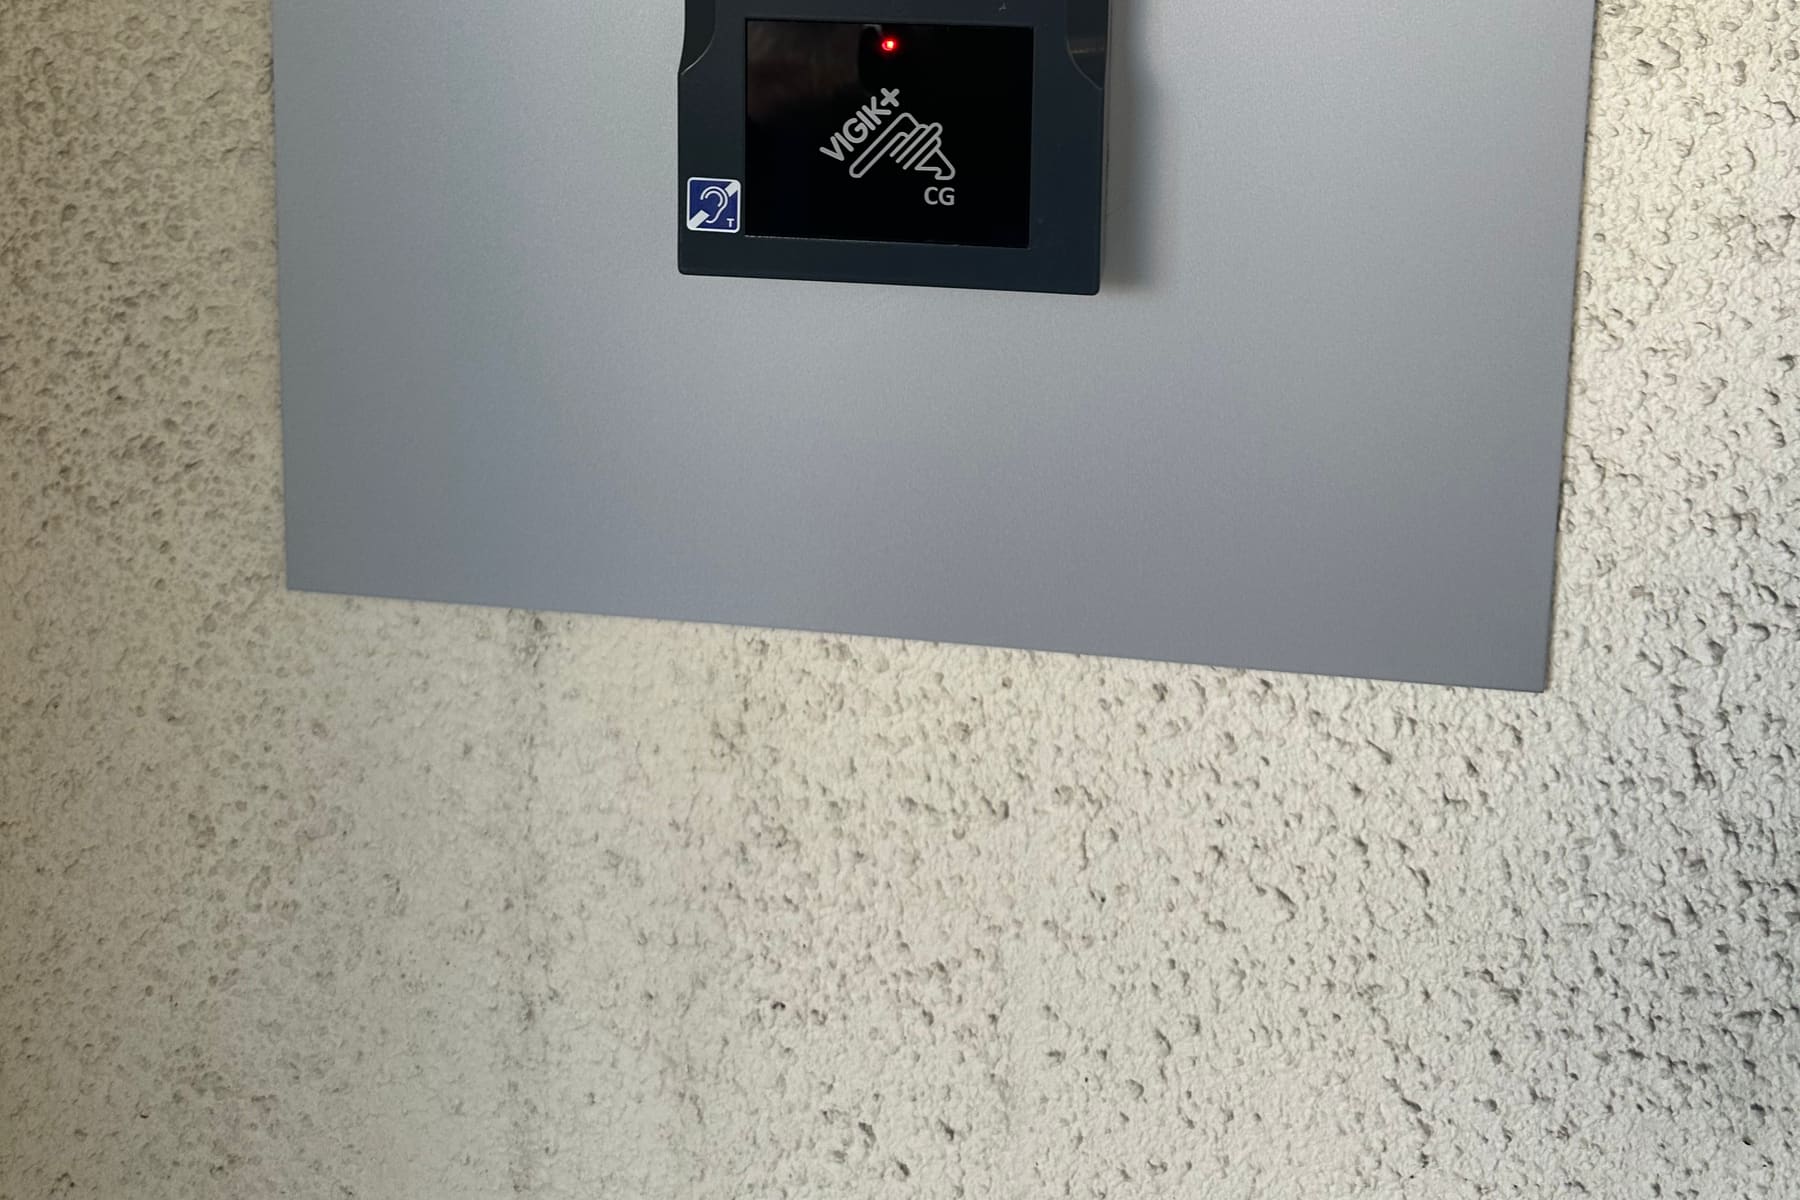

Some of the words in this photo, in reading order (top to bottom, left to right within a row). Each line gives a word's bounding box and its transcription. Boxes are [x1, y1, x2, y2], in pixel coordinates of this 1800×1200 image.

[819, 87, 901, 162] VIGIK+
[924, 186, 956, 206] CG
[725, 217, 735, 228] T
